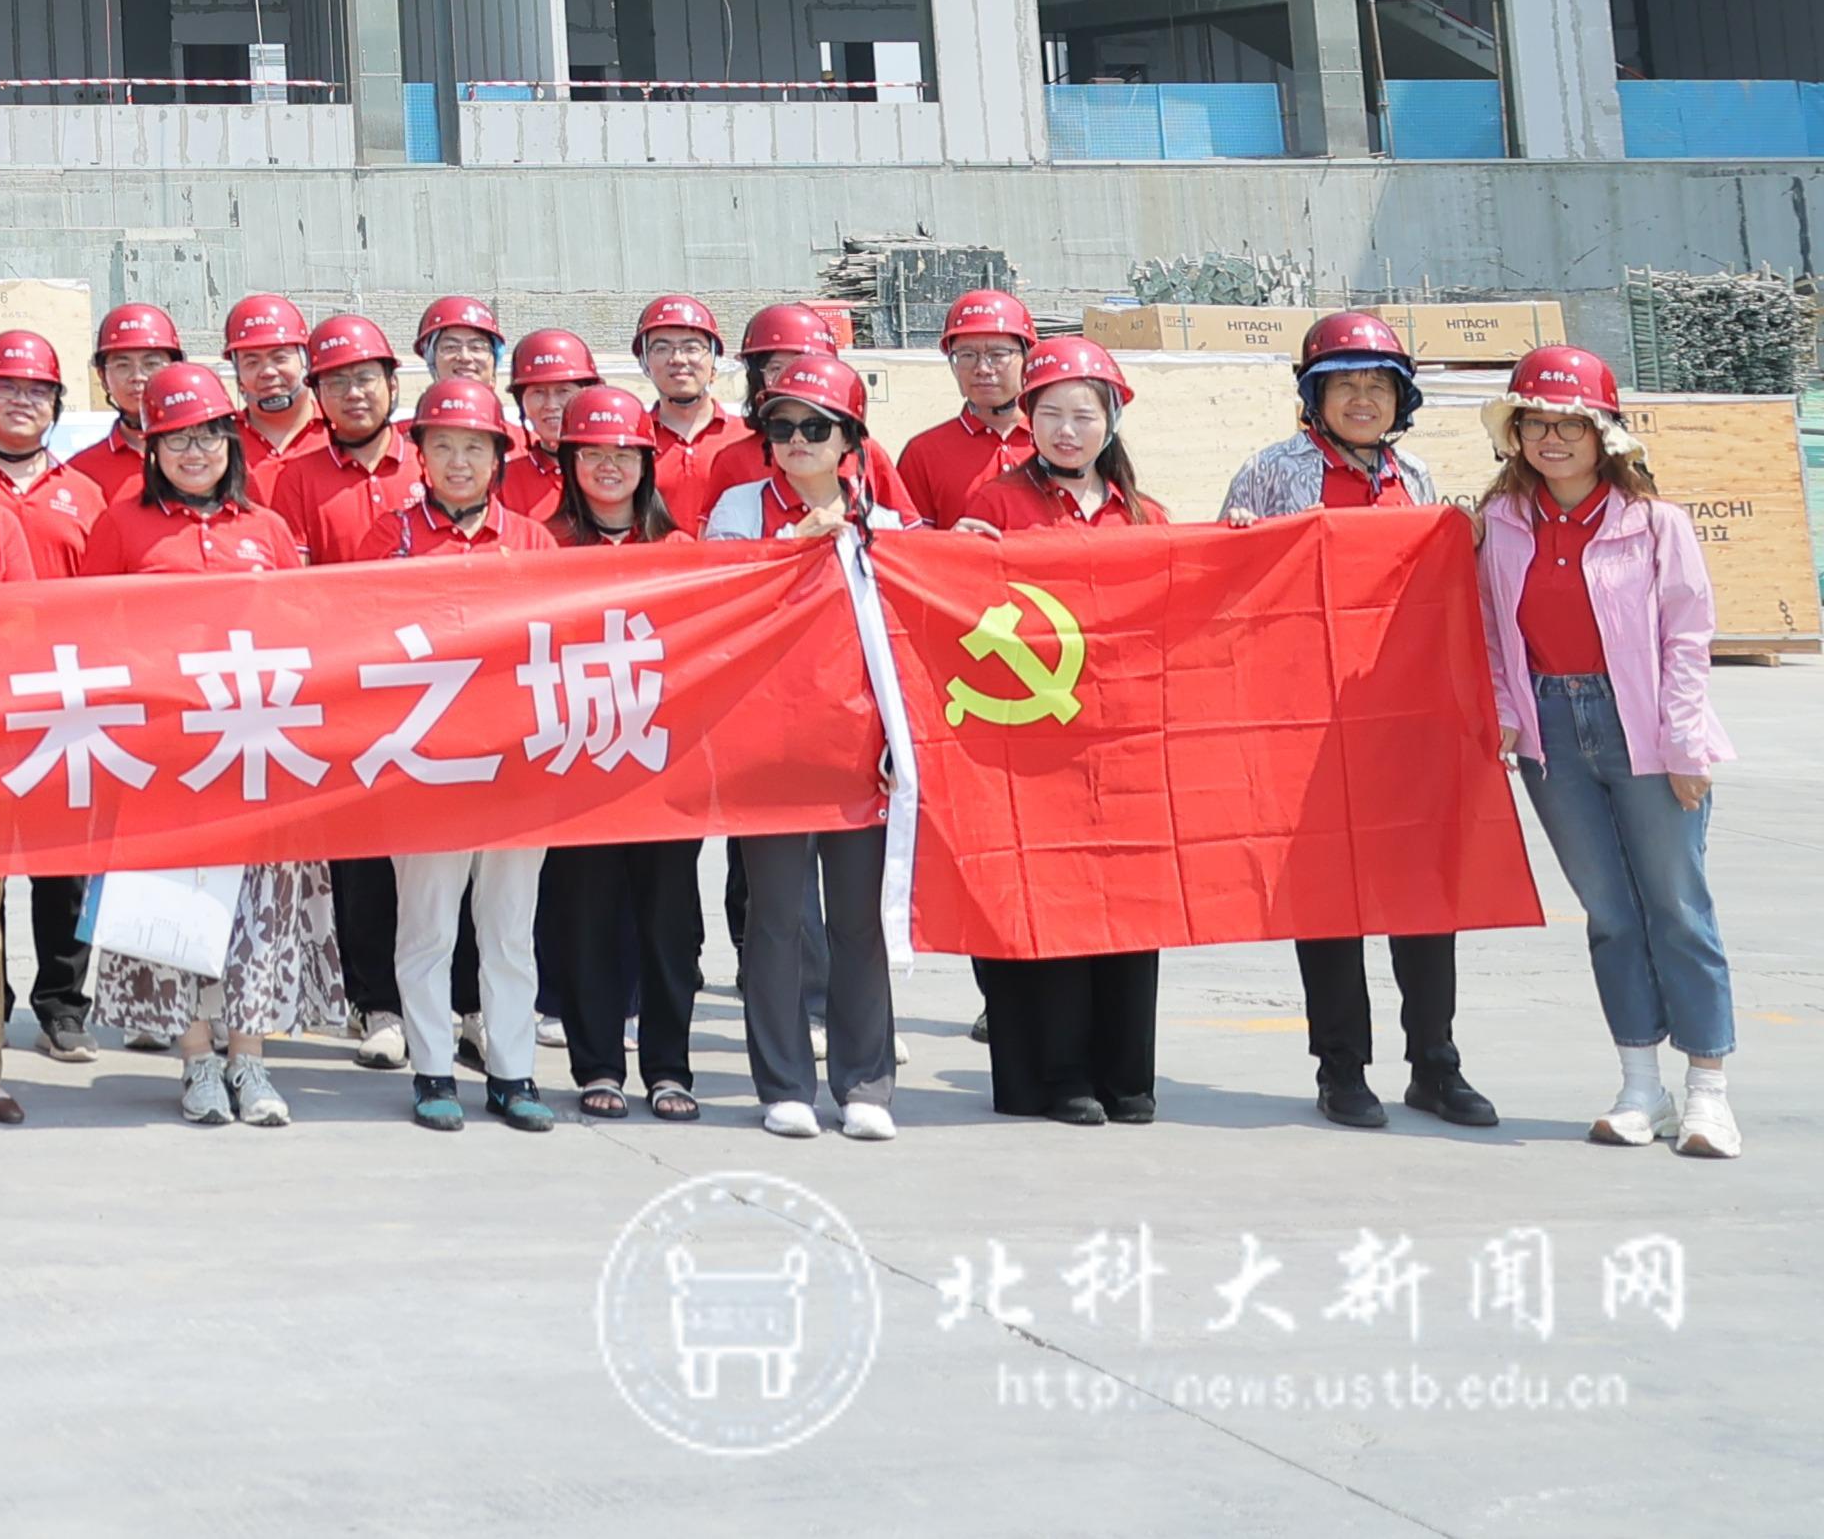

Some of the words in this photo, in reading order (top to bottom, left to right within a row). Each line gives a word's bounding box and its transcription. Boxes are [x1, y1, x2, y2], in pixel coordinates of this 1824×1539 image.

[1227, 320, 1282, 331] HITACHI
[1446, 318, 1498, 329] HITACHI
[1245, 334, 1269, 344] 日立
[1463, 332, 1486, 342] 日立
[1540, 370, 1579, 384] 北科大
[1684, 501, 1753, 518] TACHI
